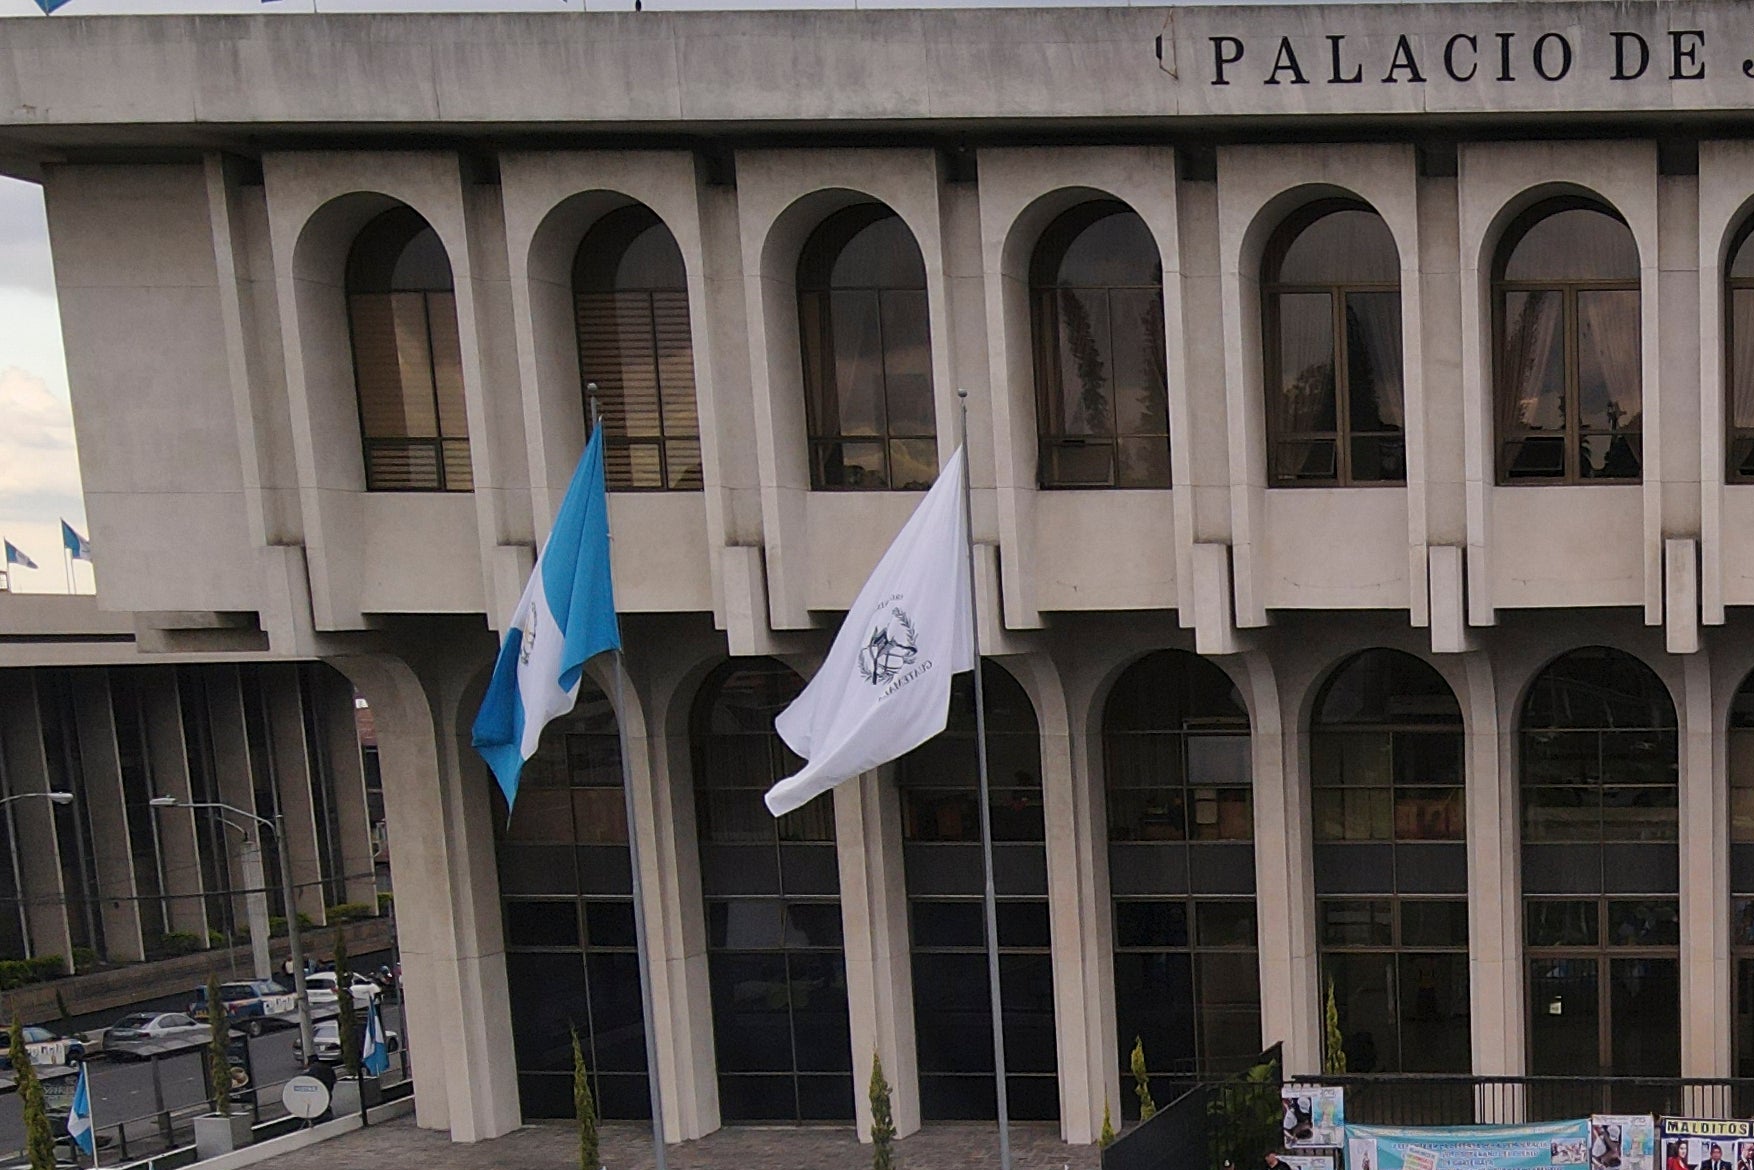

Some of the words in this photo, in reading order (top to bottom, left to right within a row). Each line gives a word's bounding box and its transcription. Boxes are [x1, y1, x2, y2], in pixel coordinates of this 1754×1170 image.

[1209, 34, 1575, 86] PALACIO
[1609, 29, 1708, 81] DE
[1667, 1121, 1749, 1135] MALDITOS
